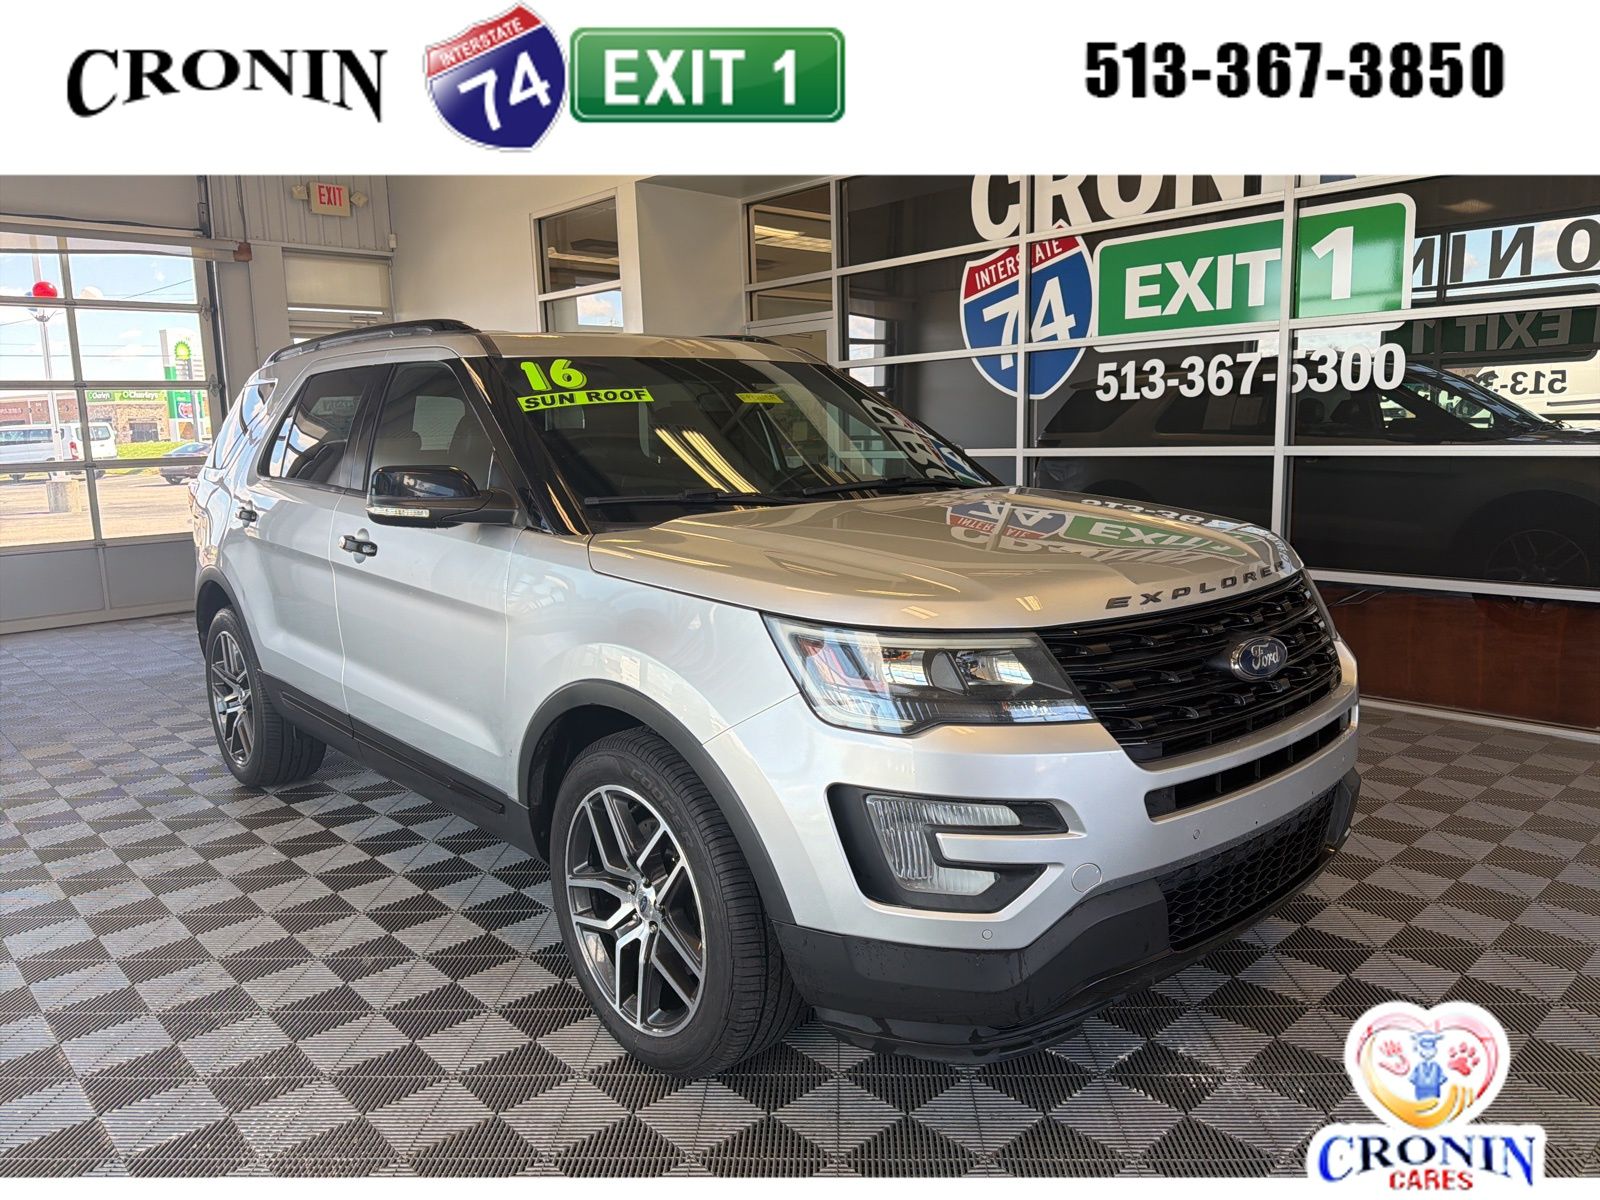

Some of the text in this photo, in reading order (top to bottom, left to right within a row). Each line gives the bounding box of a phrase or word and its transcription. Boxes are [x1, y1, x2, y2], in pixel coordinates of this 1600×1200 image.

[318, 185, 343, 207] EXIT
[1125, 226, 1354, 319] EXIT 1
[982, 276, 1076, 371] 74
[520, 359, 587, 391] 16
[524, 390, 646, 409] SUN ROOF
[1105, 560, 1287, 610] EXPLORER
[1250, 642, 1280, 670] Ford
